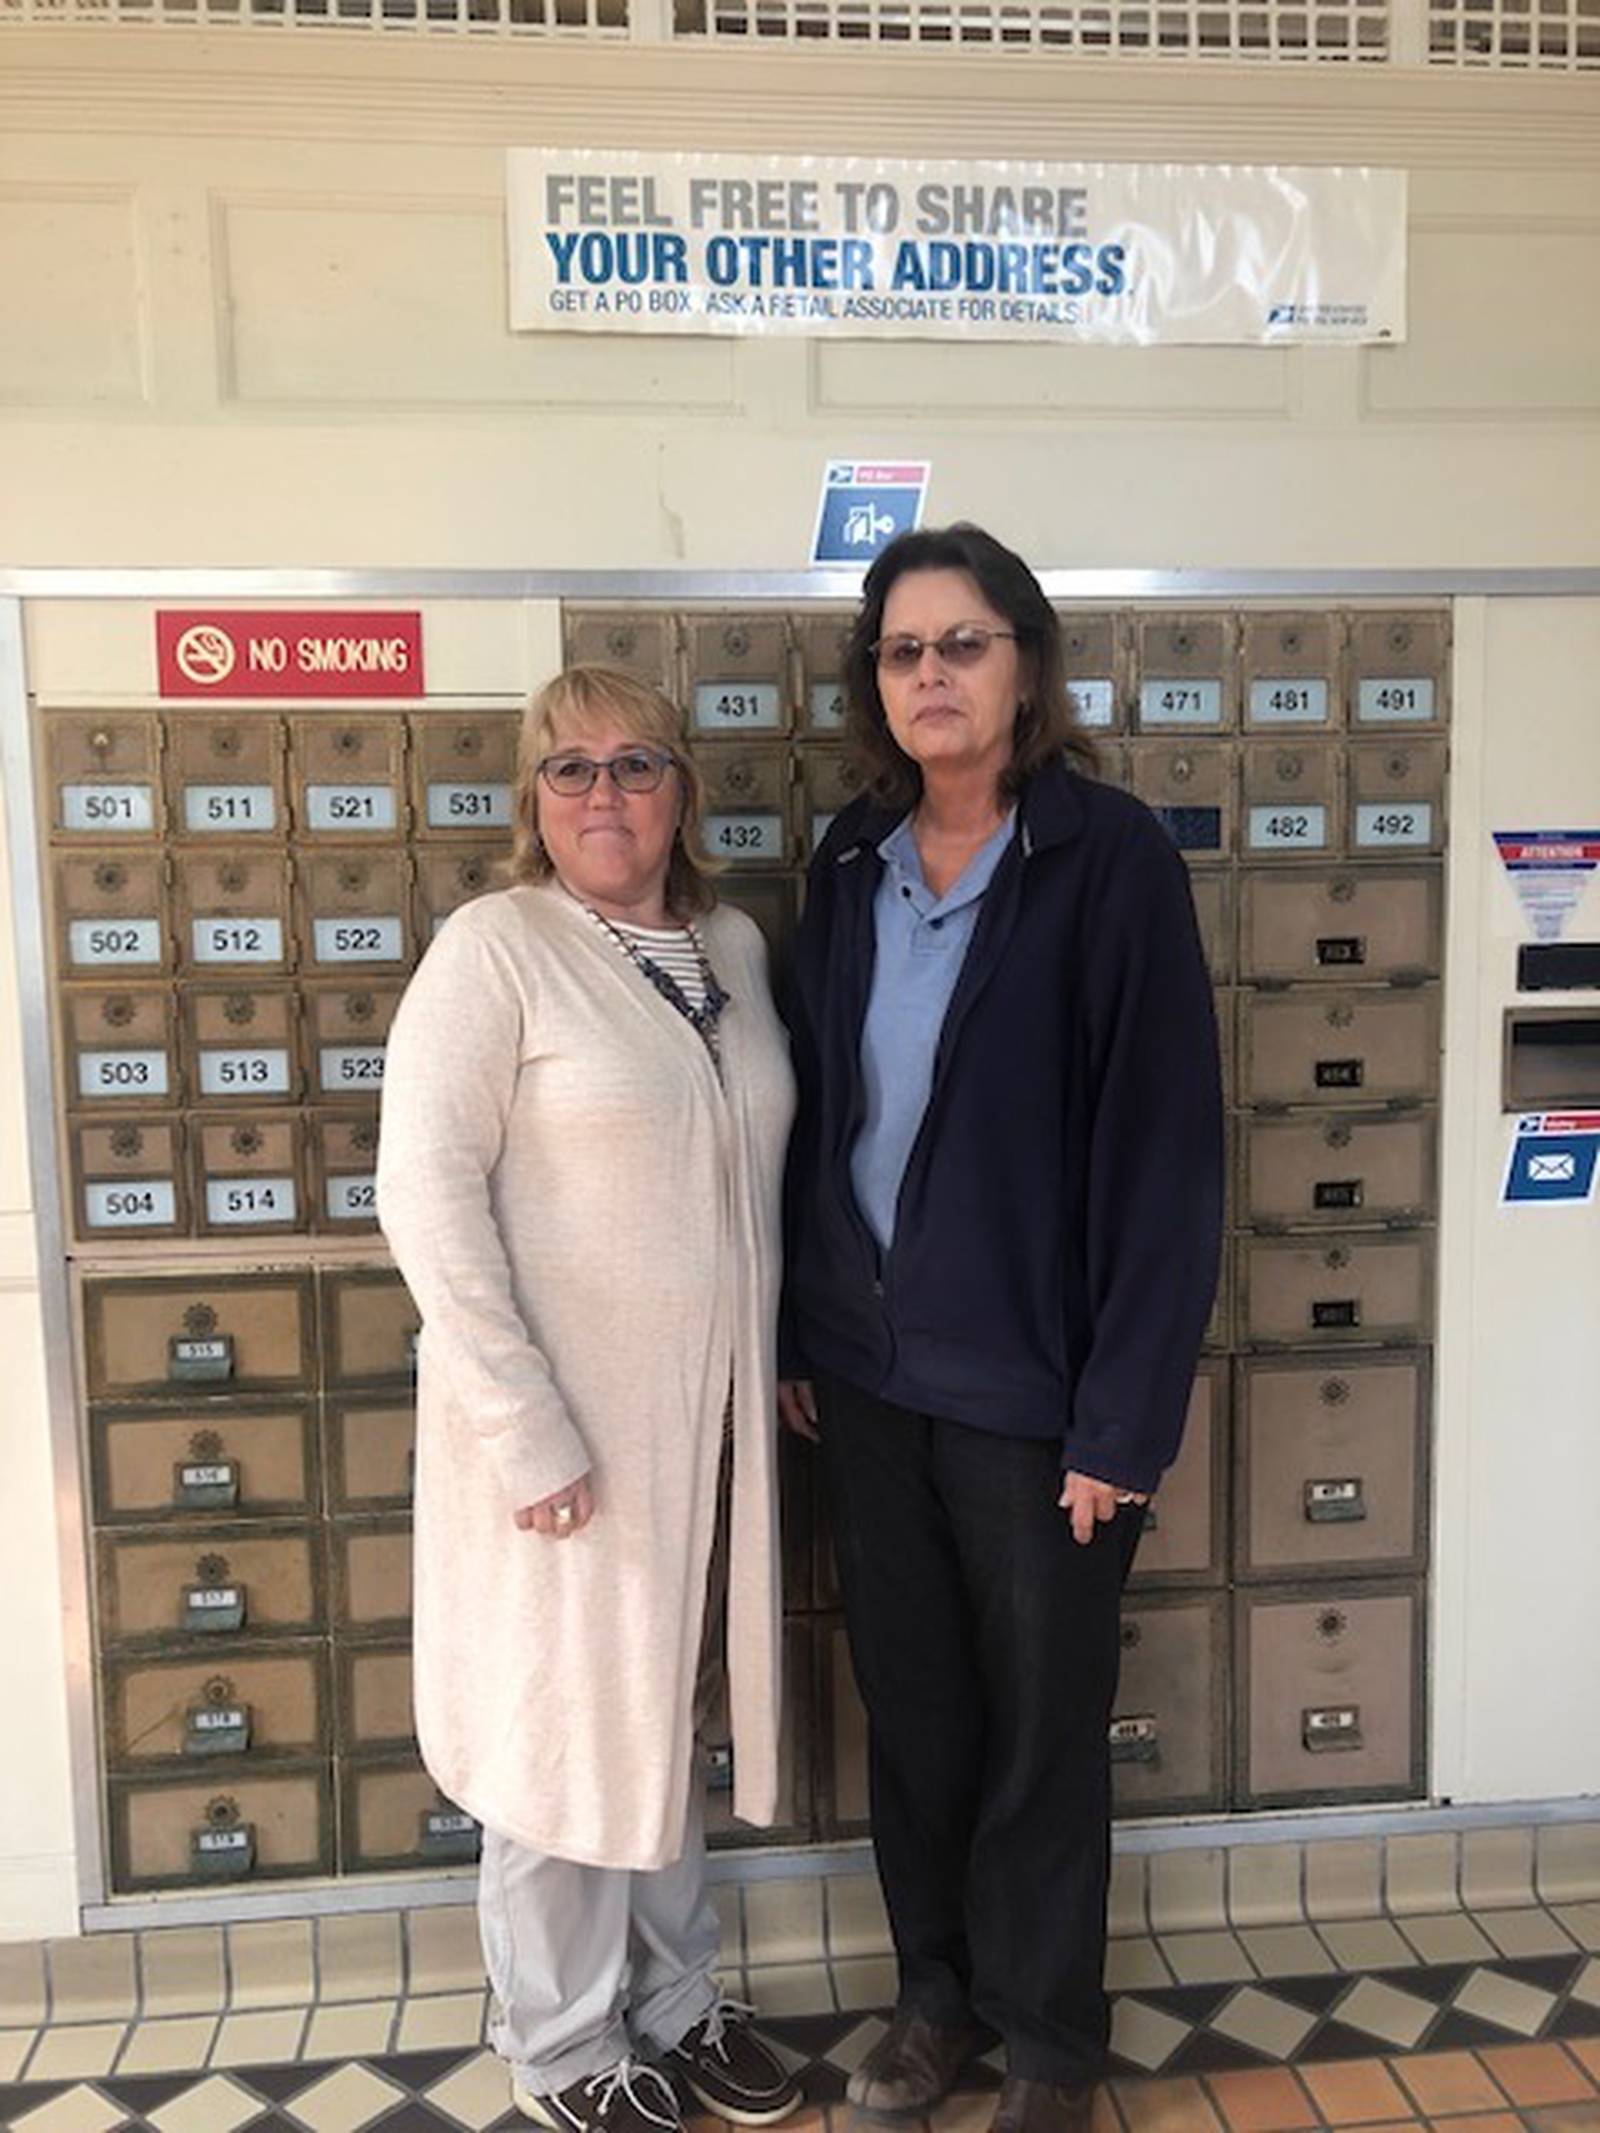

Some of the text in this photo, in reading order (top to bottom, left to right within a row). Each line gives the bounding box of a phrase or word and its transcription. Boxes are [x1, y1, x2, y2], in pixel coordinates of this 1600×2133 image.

[545, 175, 1088, 237] FEEL FREE TO SHARE
[545, 232, 688, 285] YOUR
[705, 236, 874, 291] OTHER
[550, 289, 588, 312] GET
[594, 292, 611, 312] A
[615, 290, 642, 312] PO
[705, 291, 747, 315] ASK
[751, 294, 765, 316] A
[768, 293, 836, 319] RETAIL
[843, 296, 951, 321] ASSOCIATE
[958, 298, 995, 321] FOR
[249, 637, 408, 673] NO SMOKING
[717, 695, 759, 717] 431
[1161, 689, 1201, 711] 471
[1269, 690, 1310, 711] 481
[1376, 688, 1416, 710] 491
[86, 796, 135, 819] 501
[208, 797, 253, 819] 511
[329, 796, 374, 818] 521
[448, 793, 493, 816] 531
[719, 826, 763, 847] 432
[1265, 816, 1309, 838] 482
[1372, 814, 1415, 836] 492
[91, 929, 139, 952] 502
[213, 929, 261, 952] 512
[335, 928, 381, 951] 522
[101, 1062, 148, 1085] 503
[220, 1059, 268, 1083] 513
[341, 1057, 384, 1080] 523
[106, 1193, 154, 1215] 504
[228, 1189, 275, 1212] 514
[347, 1185, 376, 1207] 52
